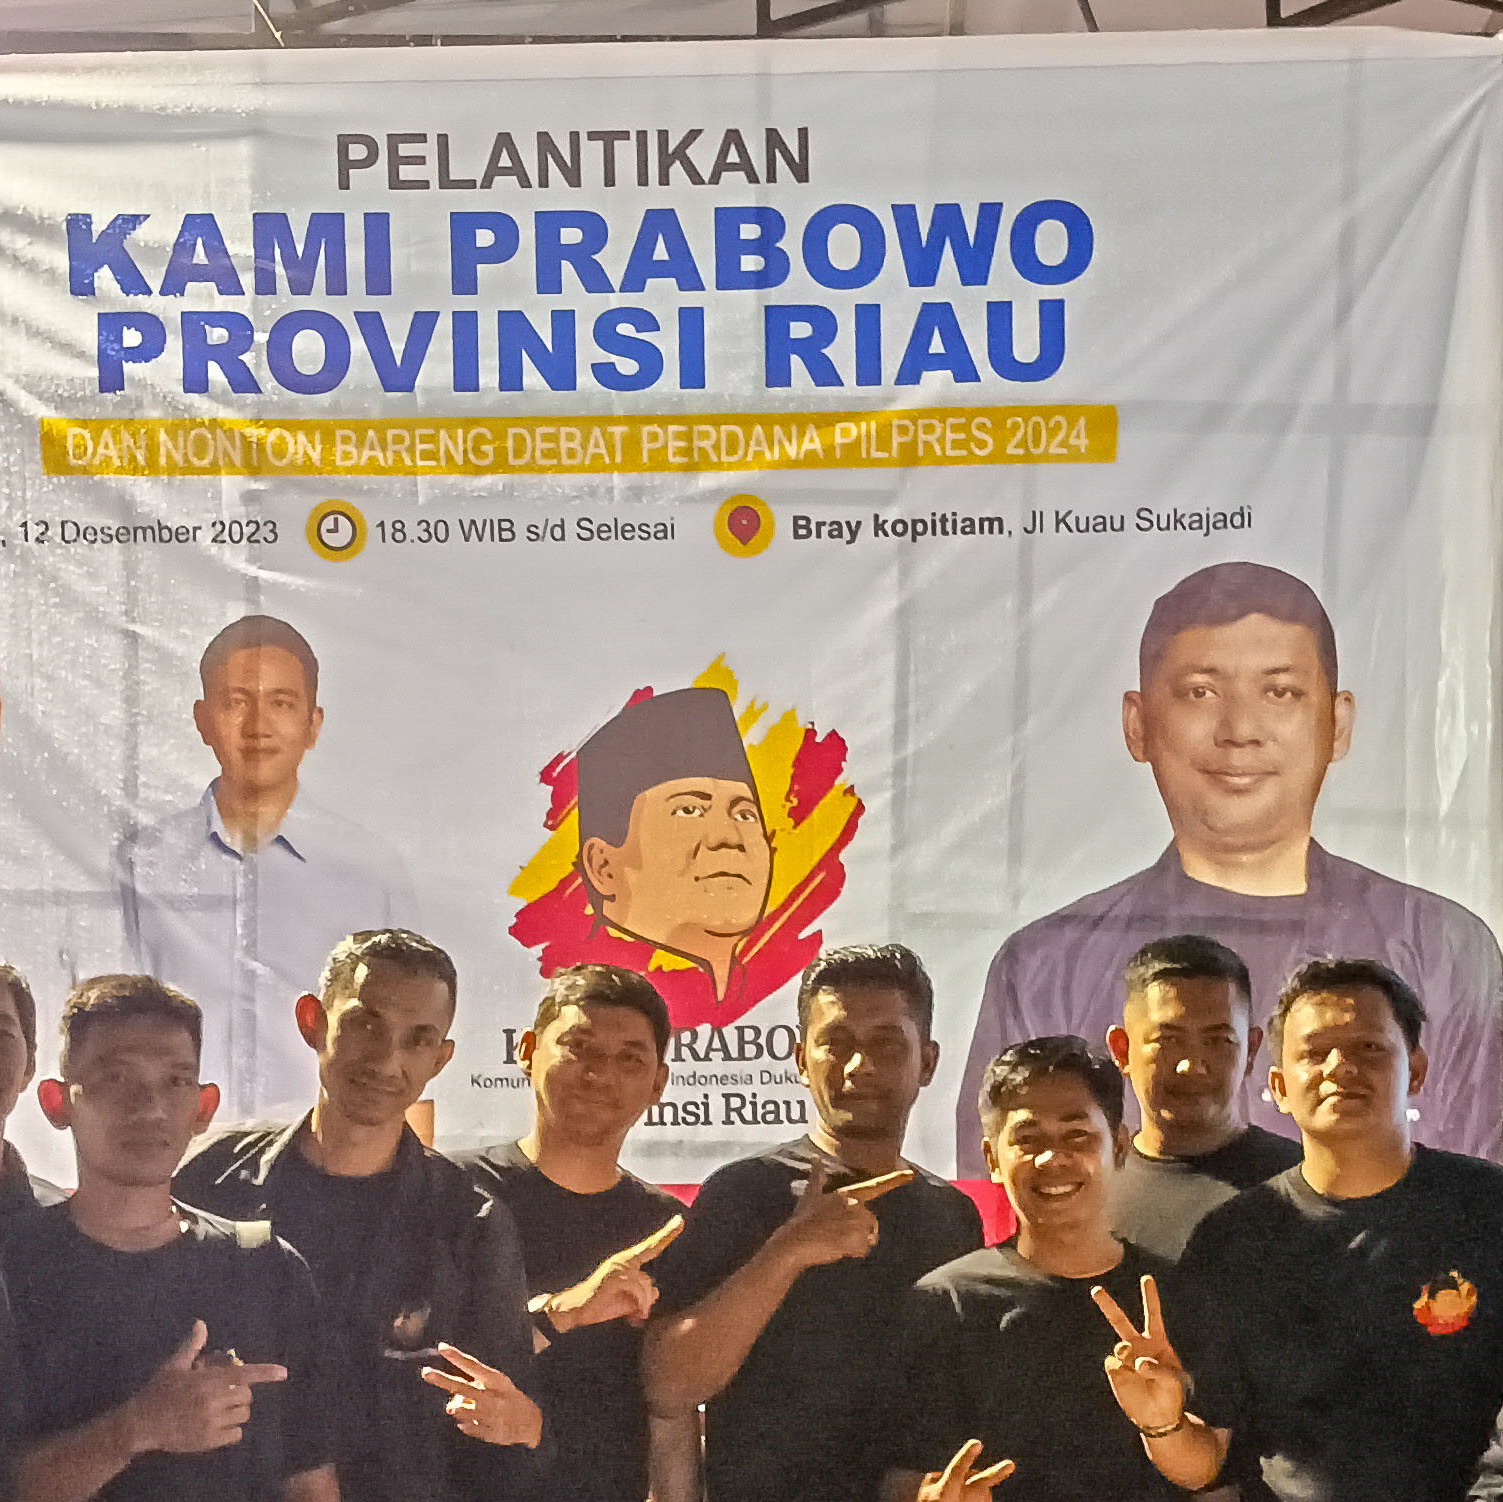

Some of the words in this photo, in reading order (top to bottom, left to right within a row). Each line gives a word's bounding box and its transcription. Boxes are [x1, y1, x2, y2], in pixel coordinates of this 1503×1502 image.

[336, 126, 811, 191] PELANTIKAN
[66, 212, 393, 297] KAMI
[449, 199, 1095, 296] PRABOWO
[97, 306, 707, 393] PROVINSI
[764, 298, 1067, 390] RIAU
[66, 427, 146, 466] DAN
[158, 427, 324, 467] NONTON
[334, 427, 495, 466] BARENG
[506, 425, 629, 465] DEBAT
[642, 422, 823, 463] PERDANA
[834, 415, 994, 459] PILPRES
[1006, 415, 1090, 456] 2024
[19, 519, 49, 545] 12
[60, 518, 200, 544] Desember
[210, 519, 279, 544] 2023
[375, 519, 450, 543] 18.30
[458, 518, 516, 542] WIB
[525, 517, 566, 542] s/d
[575, 516, 676, 542] Selesai
[792, 514, 862, 544] Bray
[872, 511, 1014, 543] kopitiam,
[1054, 508, 1126, 534] Kuau
[1135, 505, 1253, 537] Sukajadi
[671, 1024, 801, 1062] RABO
[470, 1073, 532, 1089] Komun
[671, 1070, 753, 1086] Indonesia
[760, 1069, 803, 1085] Duku
[722, 1092, 808, 1125] Riau
